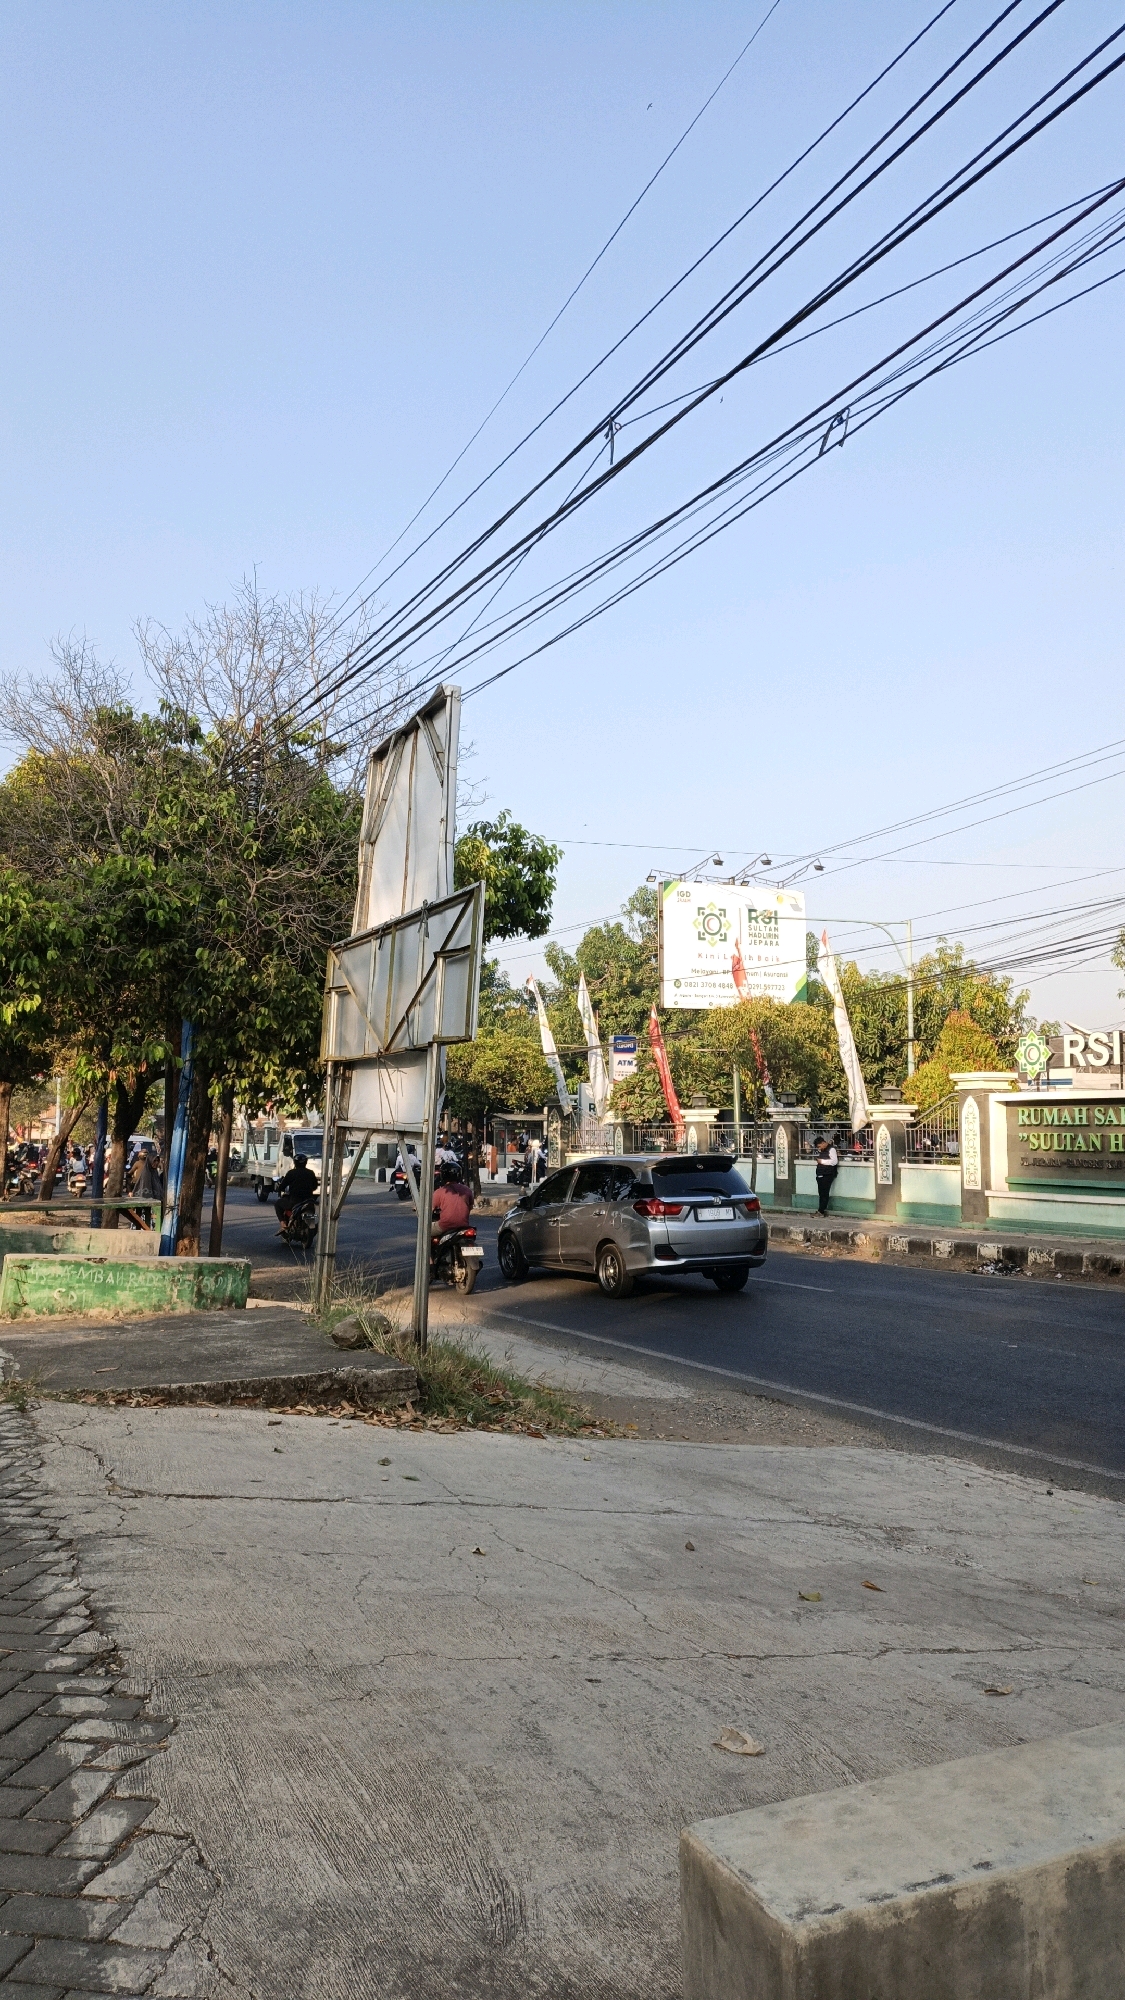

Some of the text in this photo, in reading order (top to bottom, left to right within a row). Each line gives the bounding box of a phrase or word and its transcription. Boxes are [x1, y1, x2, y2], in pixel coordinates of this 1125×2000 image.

[748, 924, 779, 932] SULTAN
[748, 939, 780, 947] JEPARA
[1063, 1030, 1121, 1067] RSI
[1017, 1106, 1090, 1126] RUMAH
